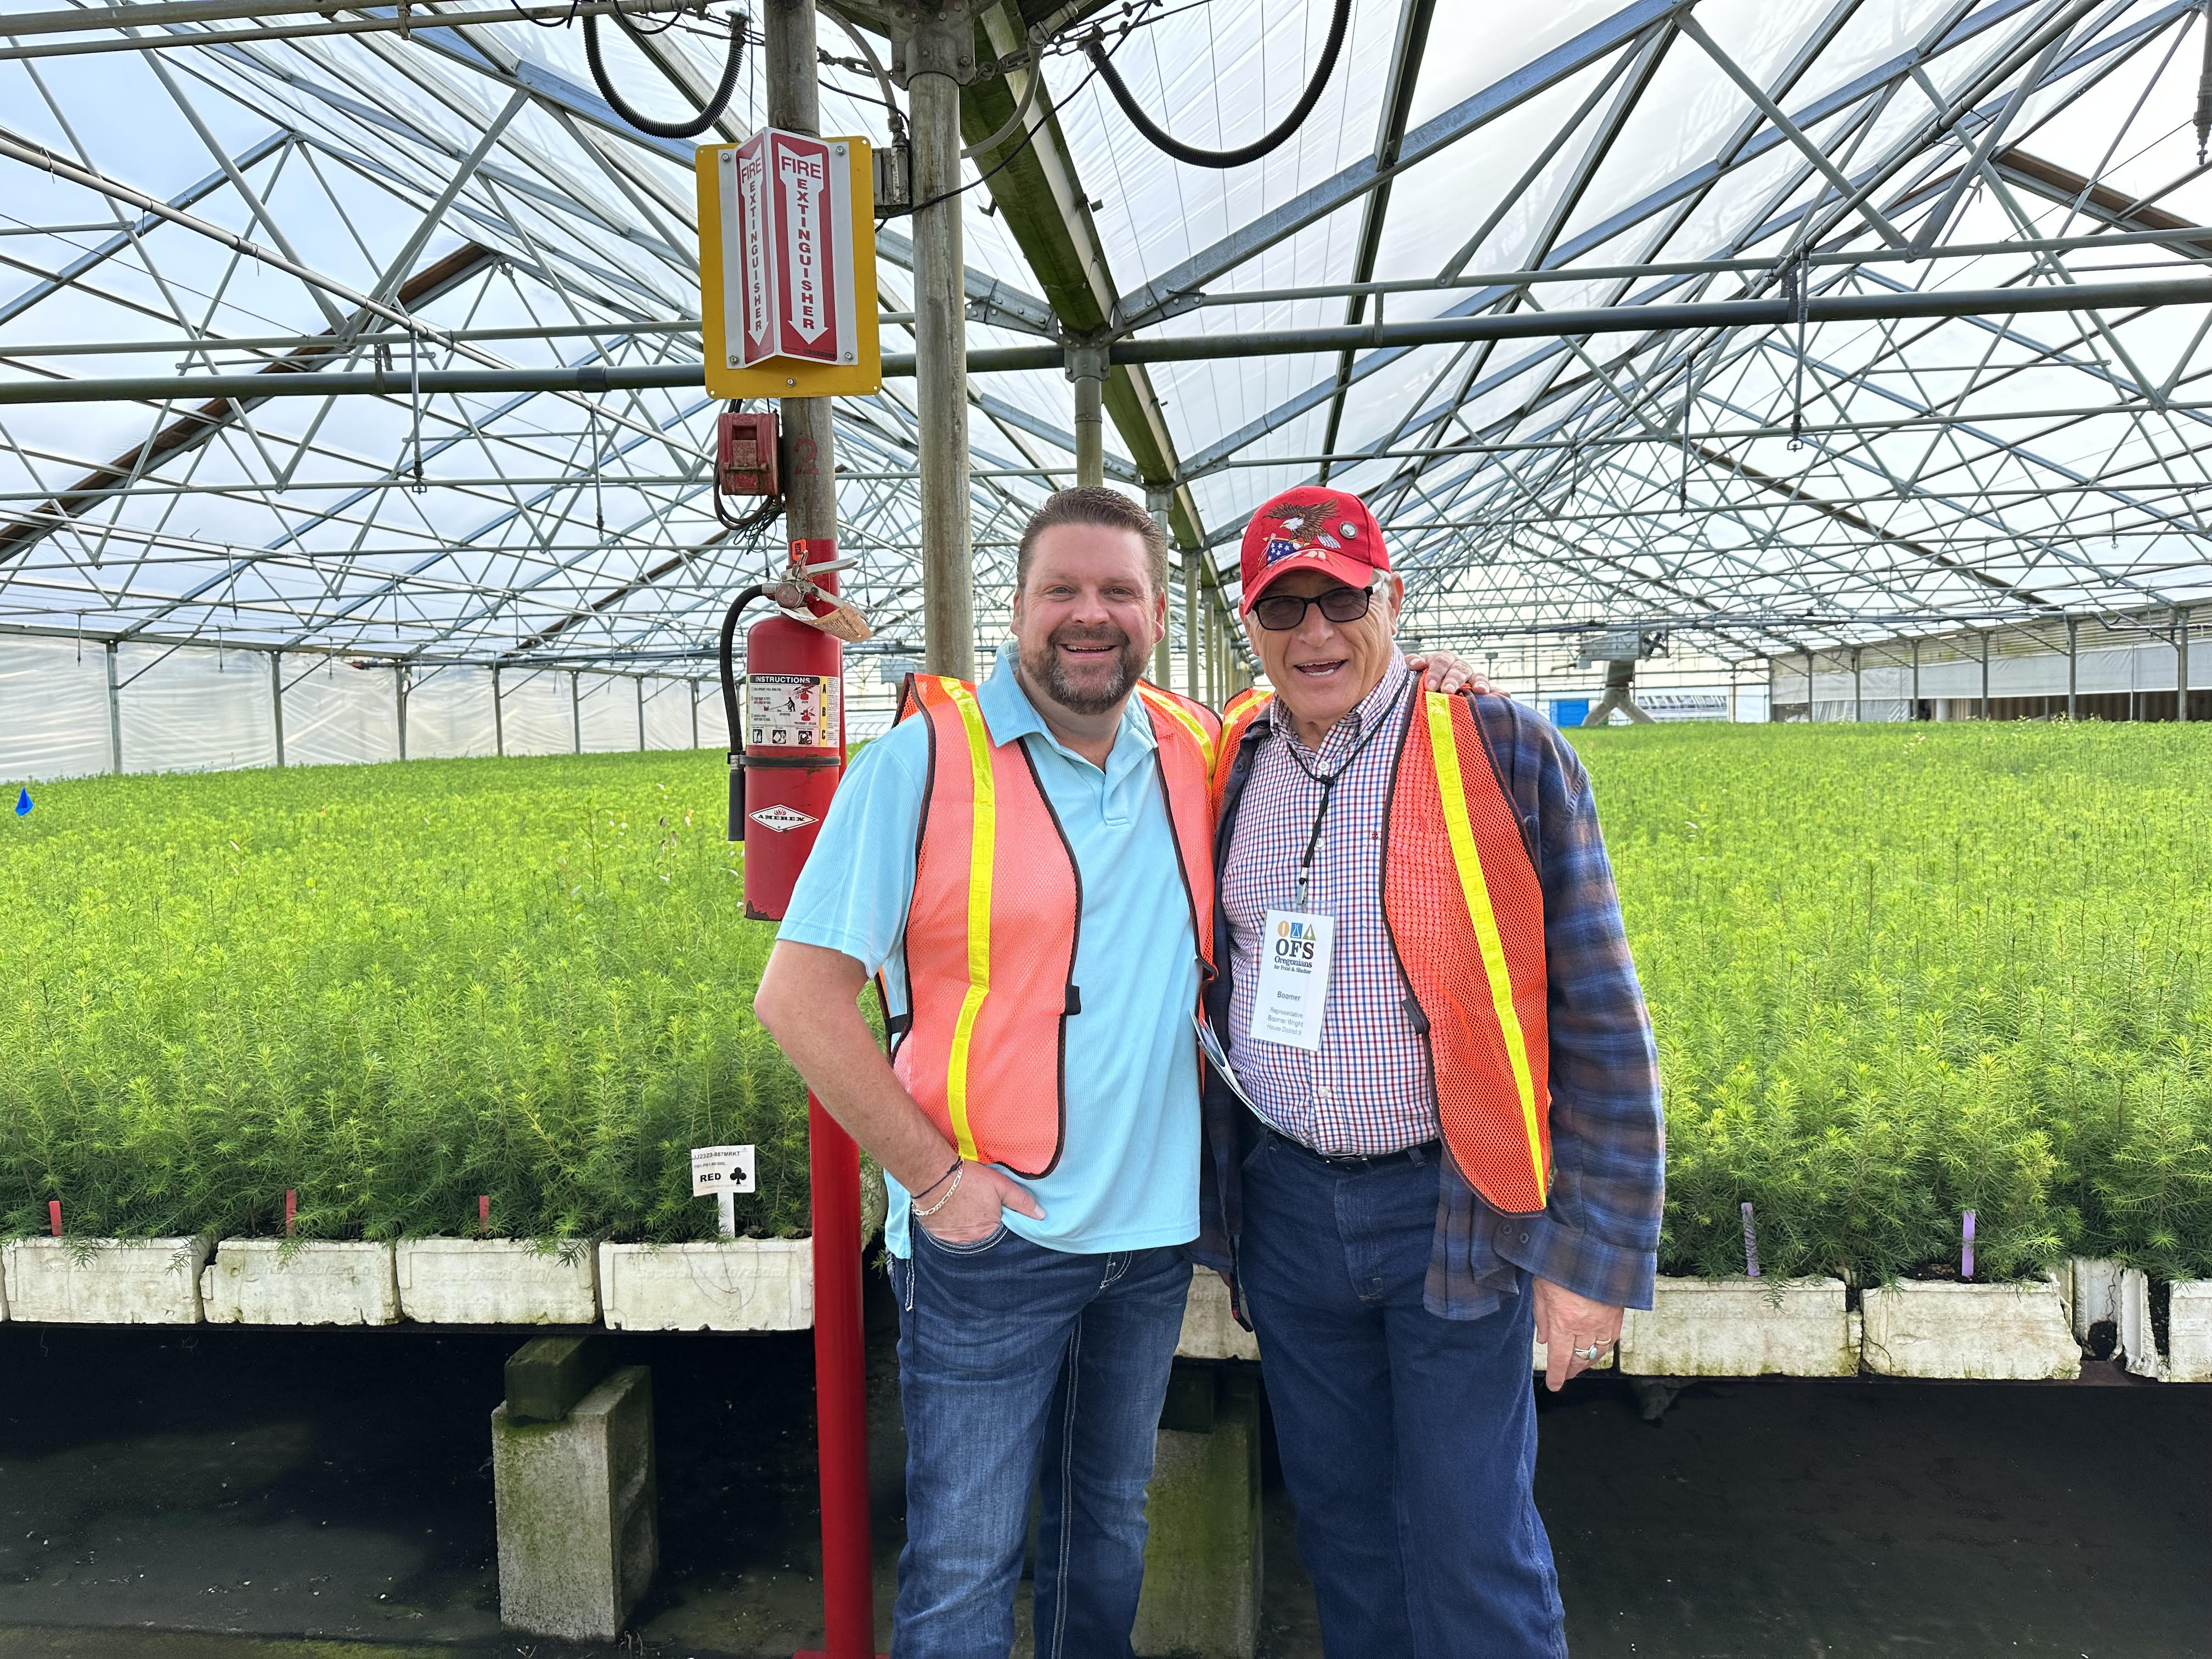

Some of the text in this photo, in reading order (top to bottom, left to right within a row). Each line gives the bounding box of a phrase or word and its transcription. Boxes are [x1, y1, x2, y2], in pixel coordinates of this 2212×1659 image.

[741, 156, 762, 184] FIRE
[781, 156, 821, 180] FIRE
[749, 182, 762, 332] EXTINGUISHER
[797, 177, 815, 330] EXTINGUISHER
[794, 438, 820, 475] 2
[822, 684, 826, 694] A
[822, 707, 826, 717] B
[821, 729, 826, 740] C
[1276, 938, 1314, 960] OFS
[1274, 955, 1312, 968] Oregonians
[1277, 991, 1301, 1001] Boomer
[1270, 1007, 1303, 1018] Representative
[1268, 1014, 1304, 1028] Boomer Wright
[1267, 1023, 1281, 1031] House
[1282, 1026, 1297, 1035] District
[700, 1172, 721, 1183] RED
